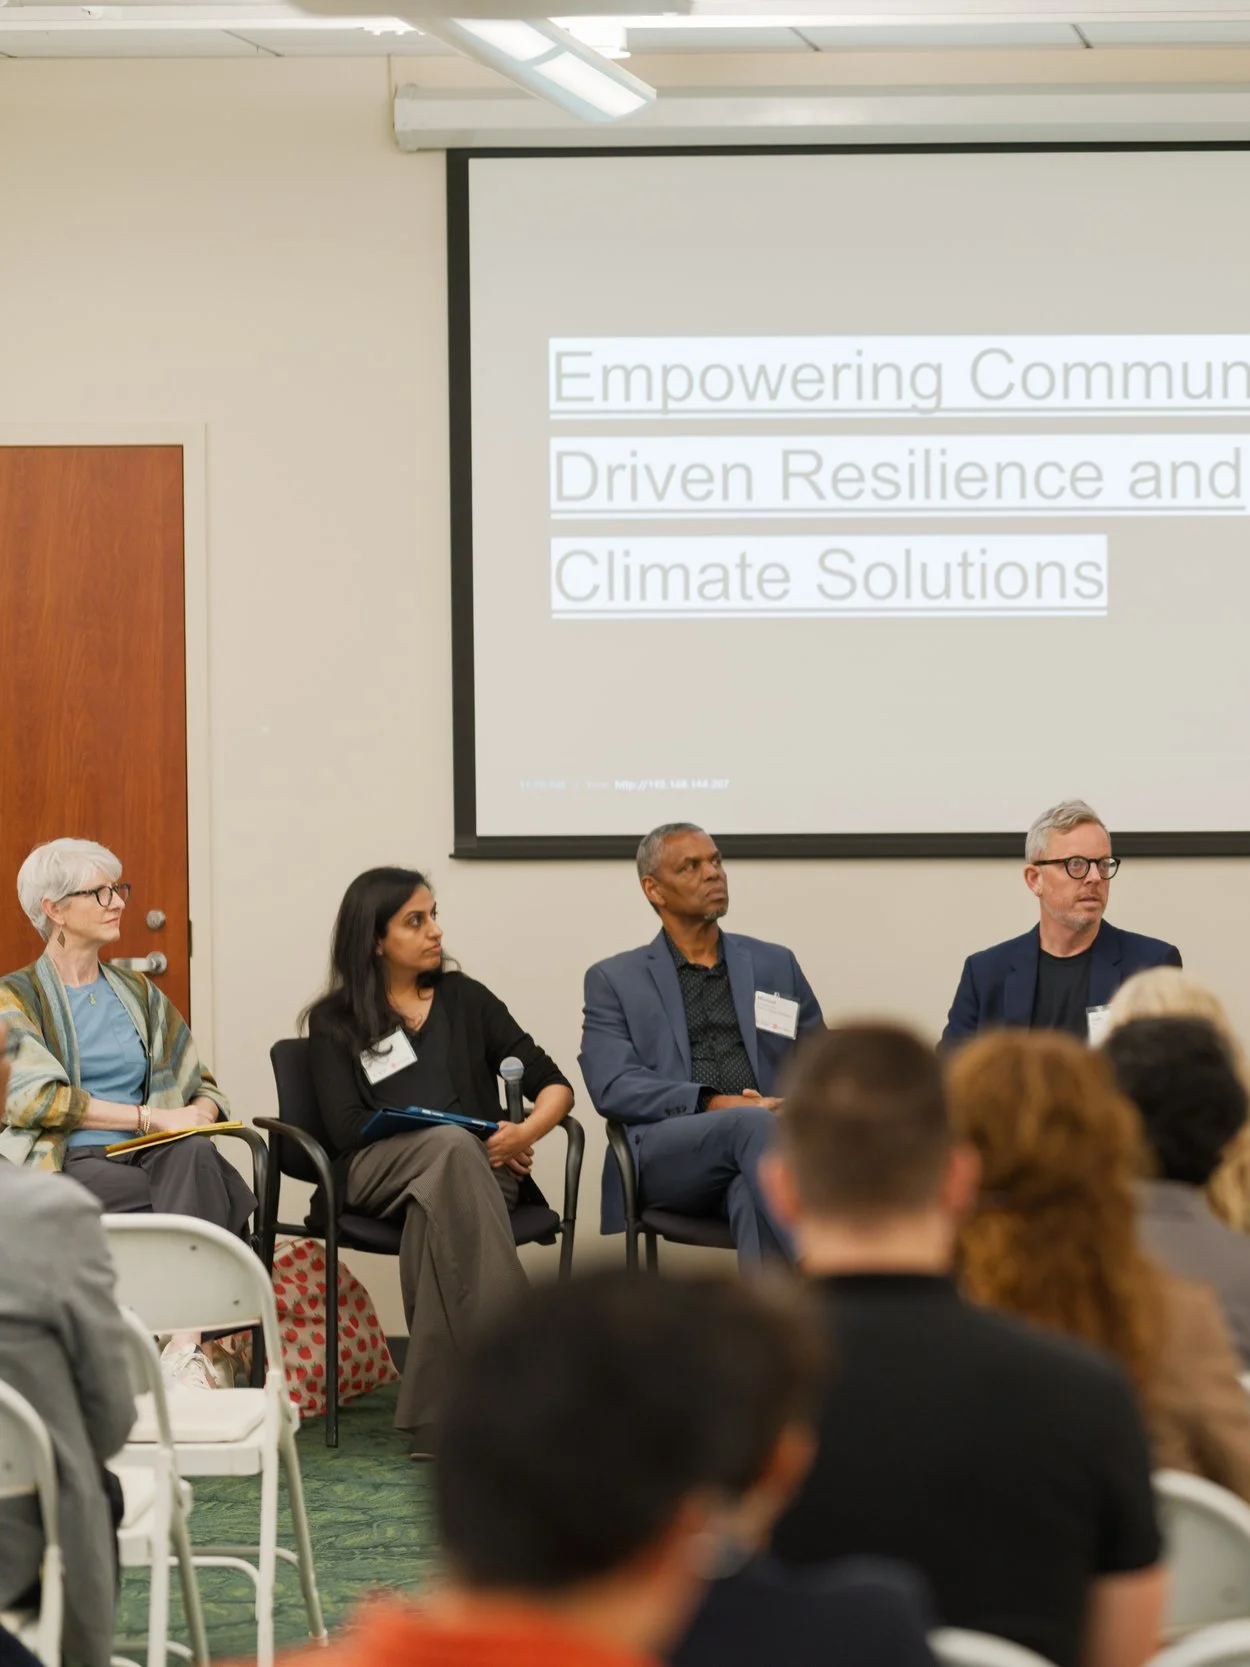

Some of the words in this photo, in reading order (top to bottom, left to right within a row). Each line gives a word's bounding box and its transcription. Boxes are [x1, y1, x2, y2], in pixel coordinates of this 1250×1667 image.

[554, 349, 944, 414] Empowering
[555, 449, 754, 502] Driven
[781, 447, 1104, 501] Resilience
[1128, 446, 1242, 500] and
[555, 548, 791, 602] Climate
[816, 547, 1105, 601] Solutions
